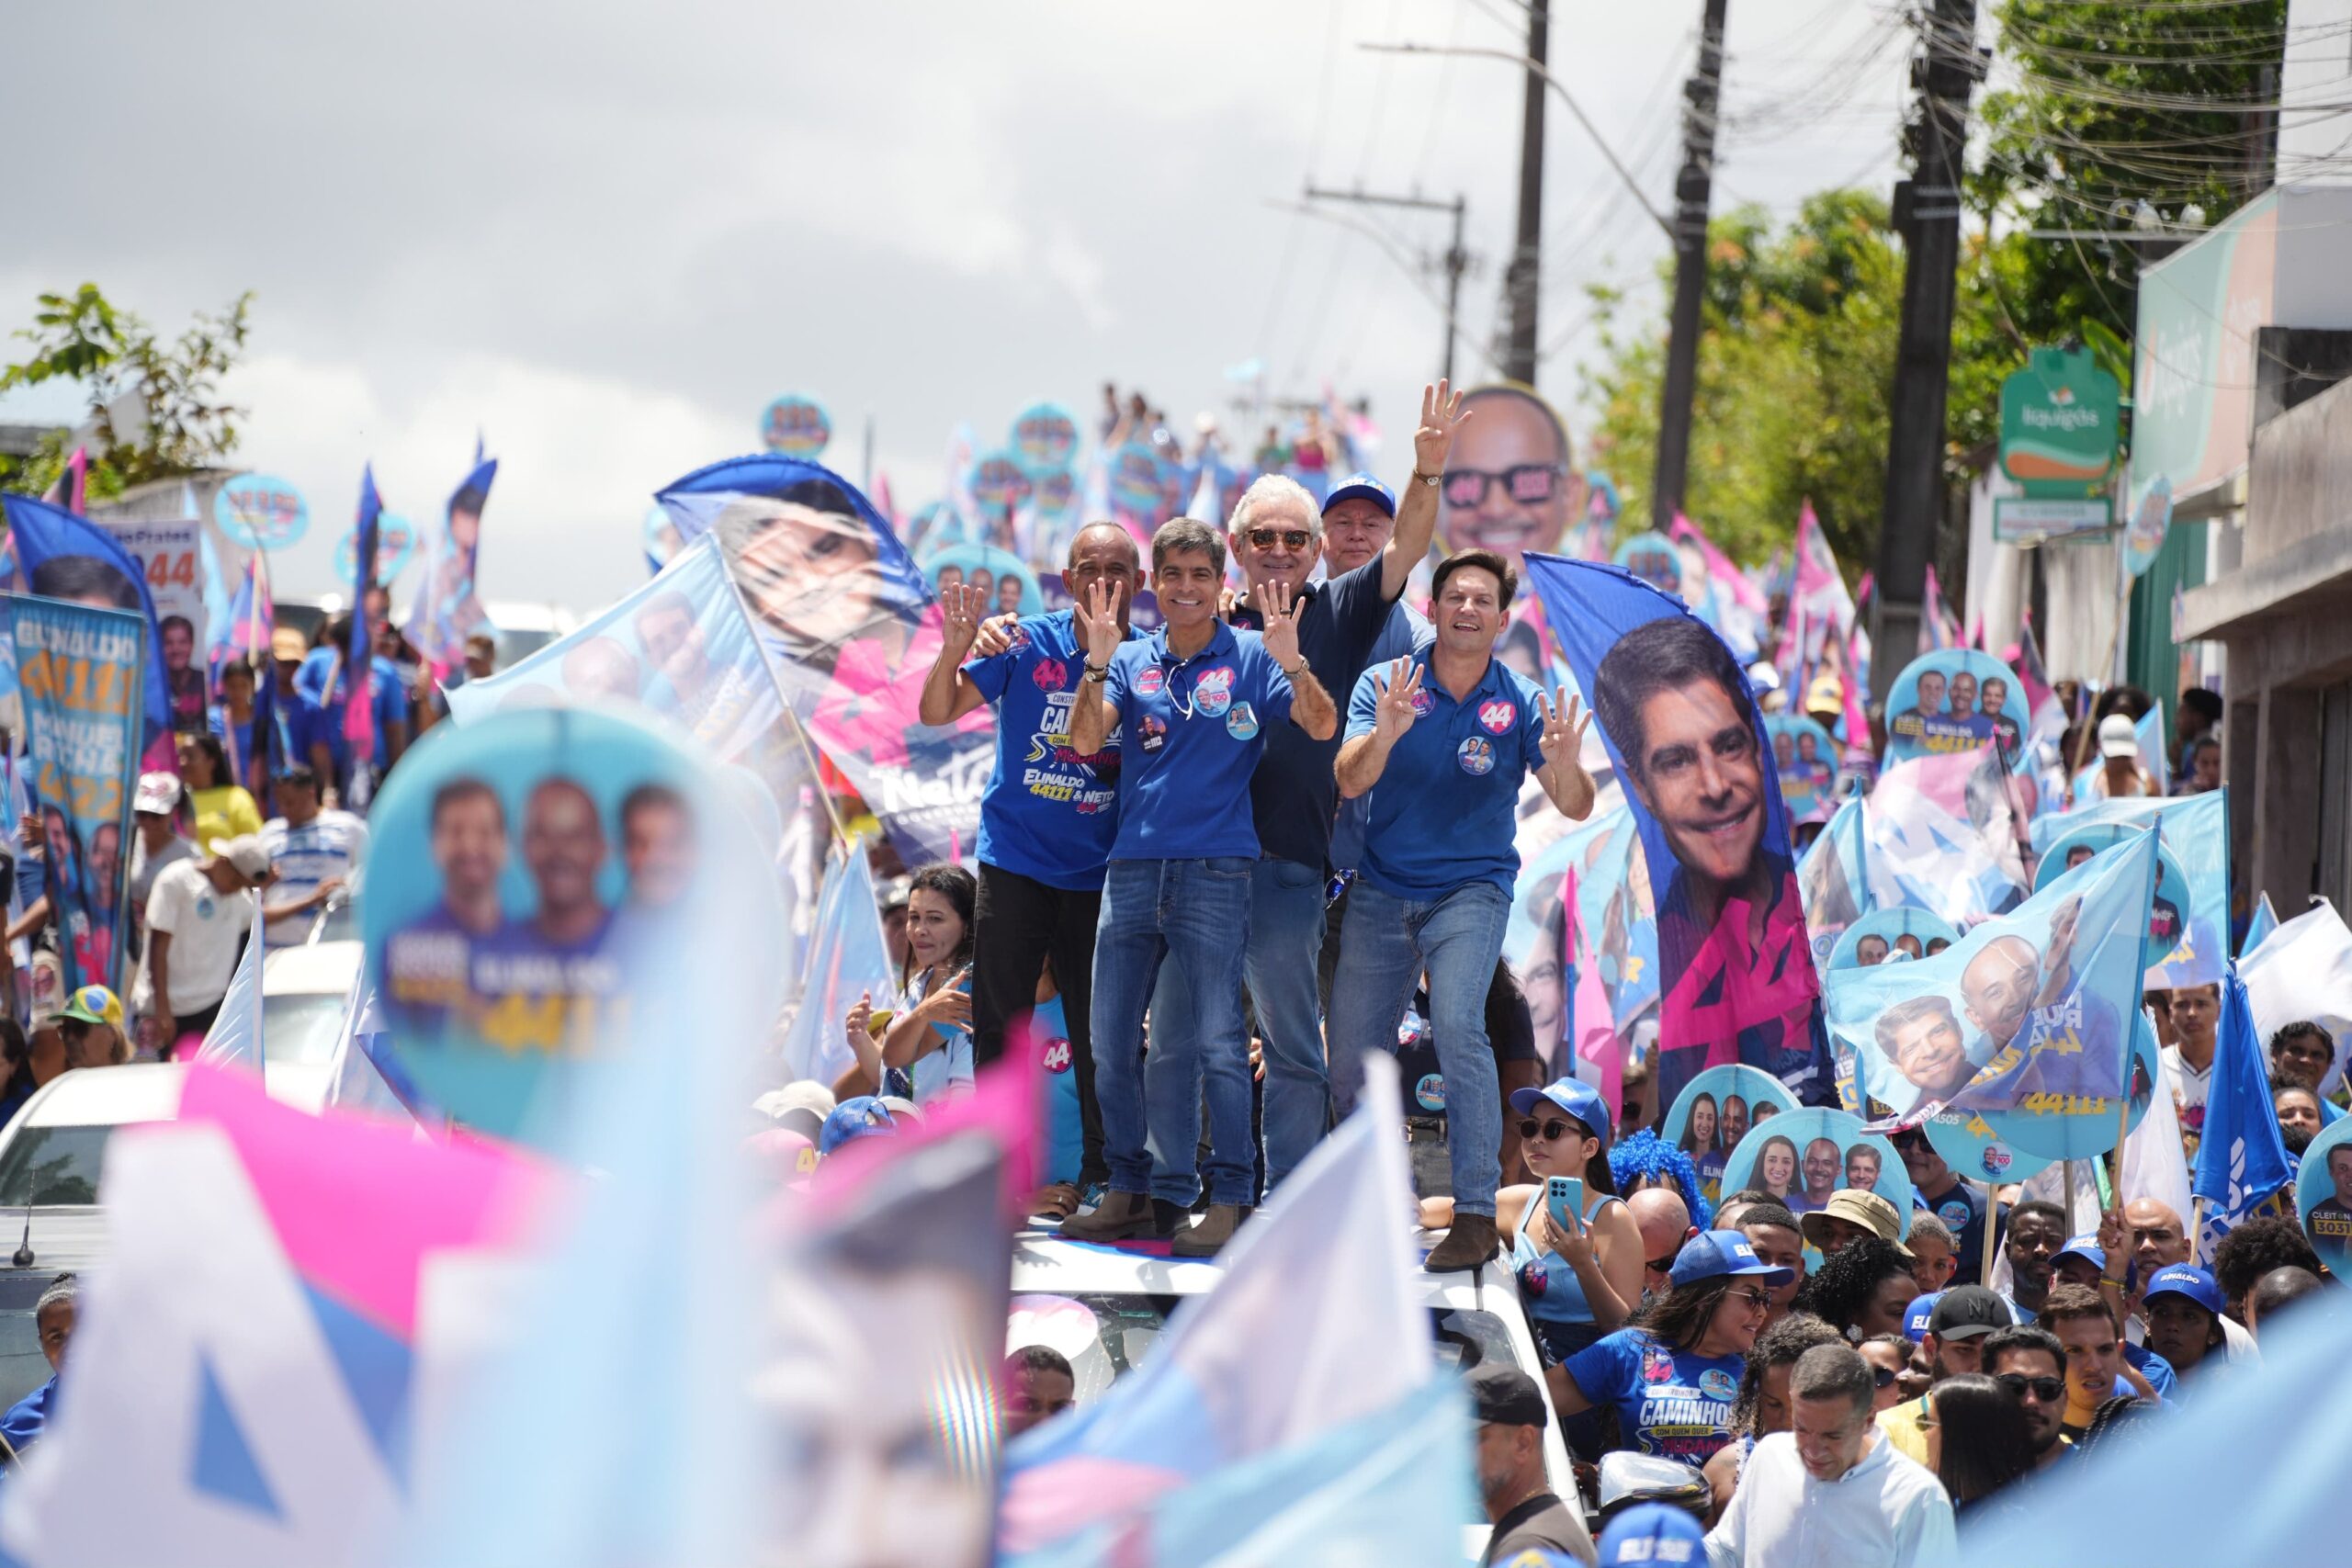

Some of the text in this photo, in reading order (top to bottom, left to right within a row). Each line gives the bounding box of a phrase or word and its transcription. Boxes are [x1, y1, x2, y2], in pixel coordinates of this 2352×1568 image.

[1481, 705, 1511, 728] 44
[1023, 768, 1085, 789] ELINALDO
[1030, 783, 1114, 804] 44111 & NETO
[1659, 872, 1818, 1068] 44
[1044, 1043, 1069, 1068] 44
[2025, 1091, 2107, 1116] 44111
[1703, 1166, 1724, 1177] ELINA
[1968, 1292, 1996, 1324] NY
[1639, 1399, 1731, 1426] CAMINHO
